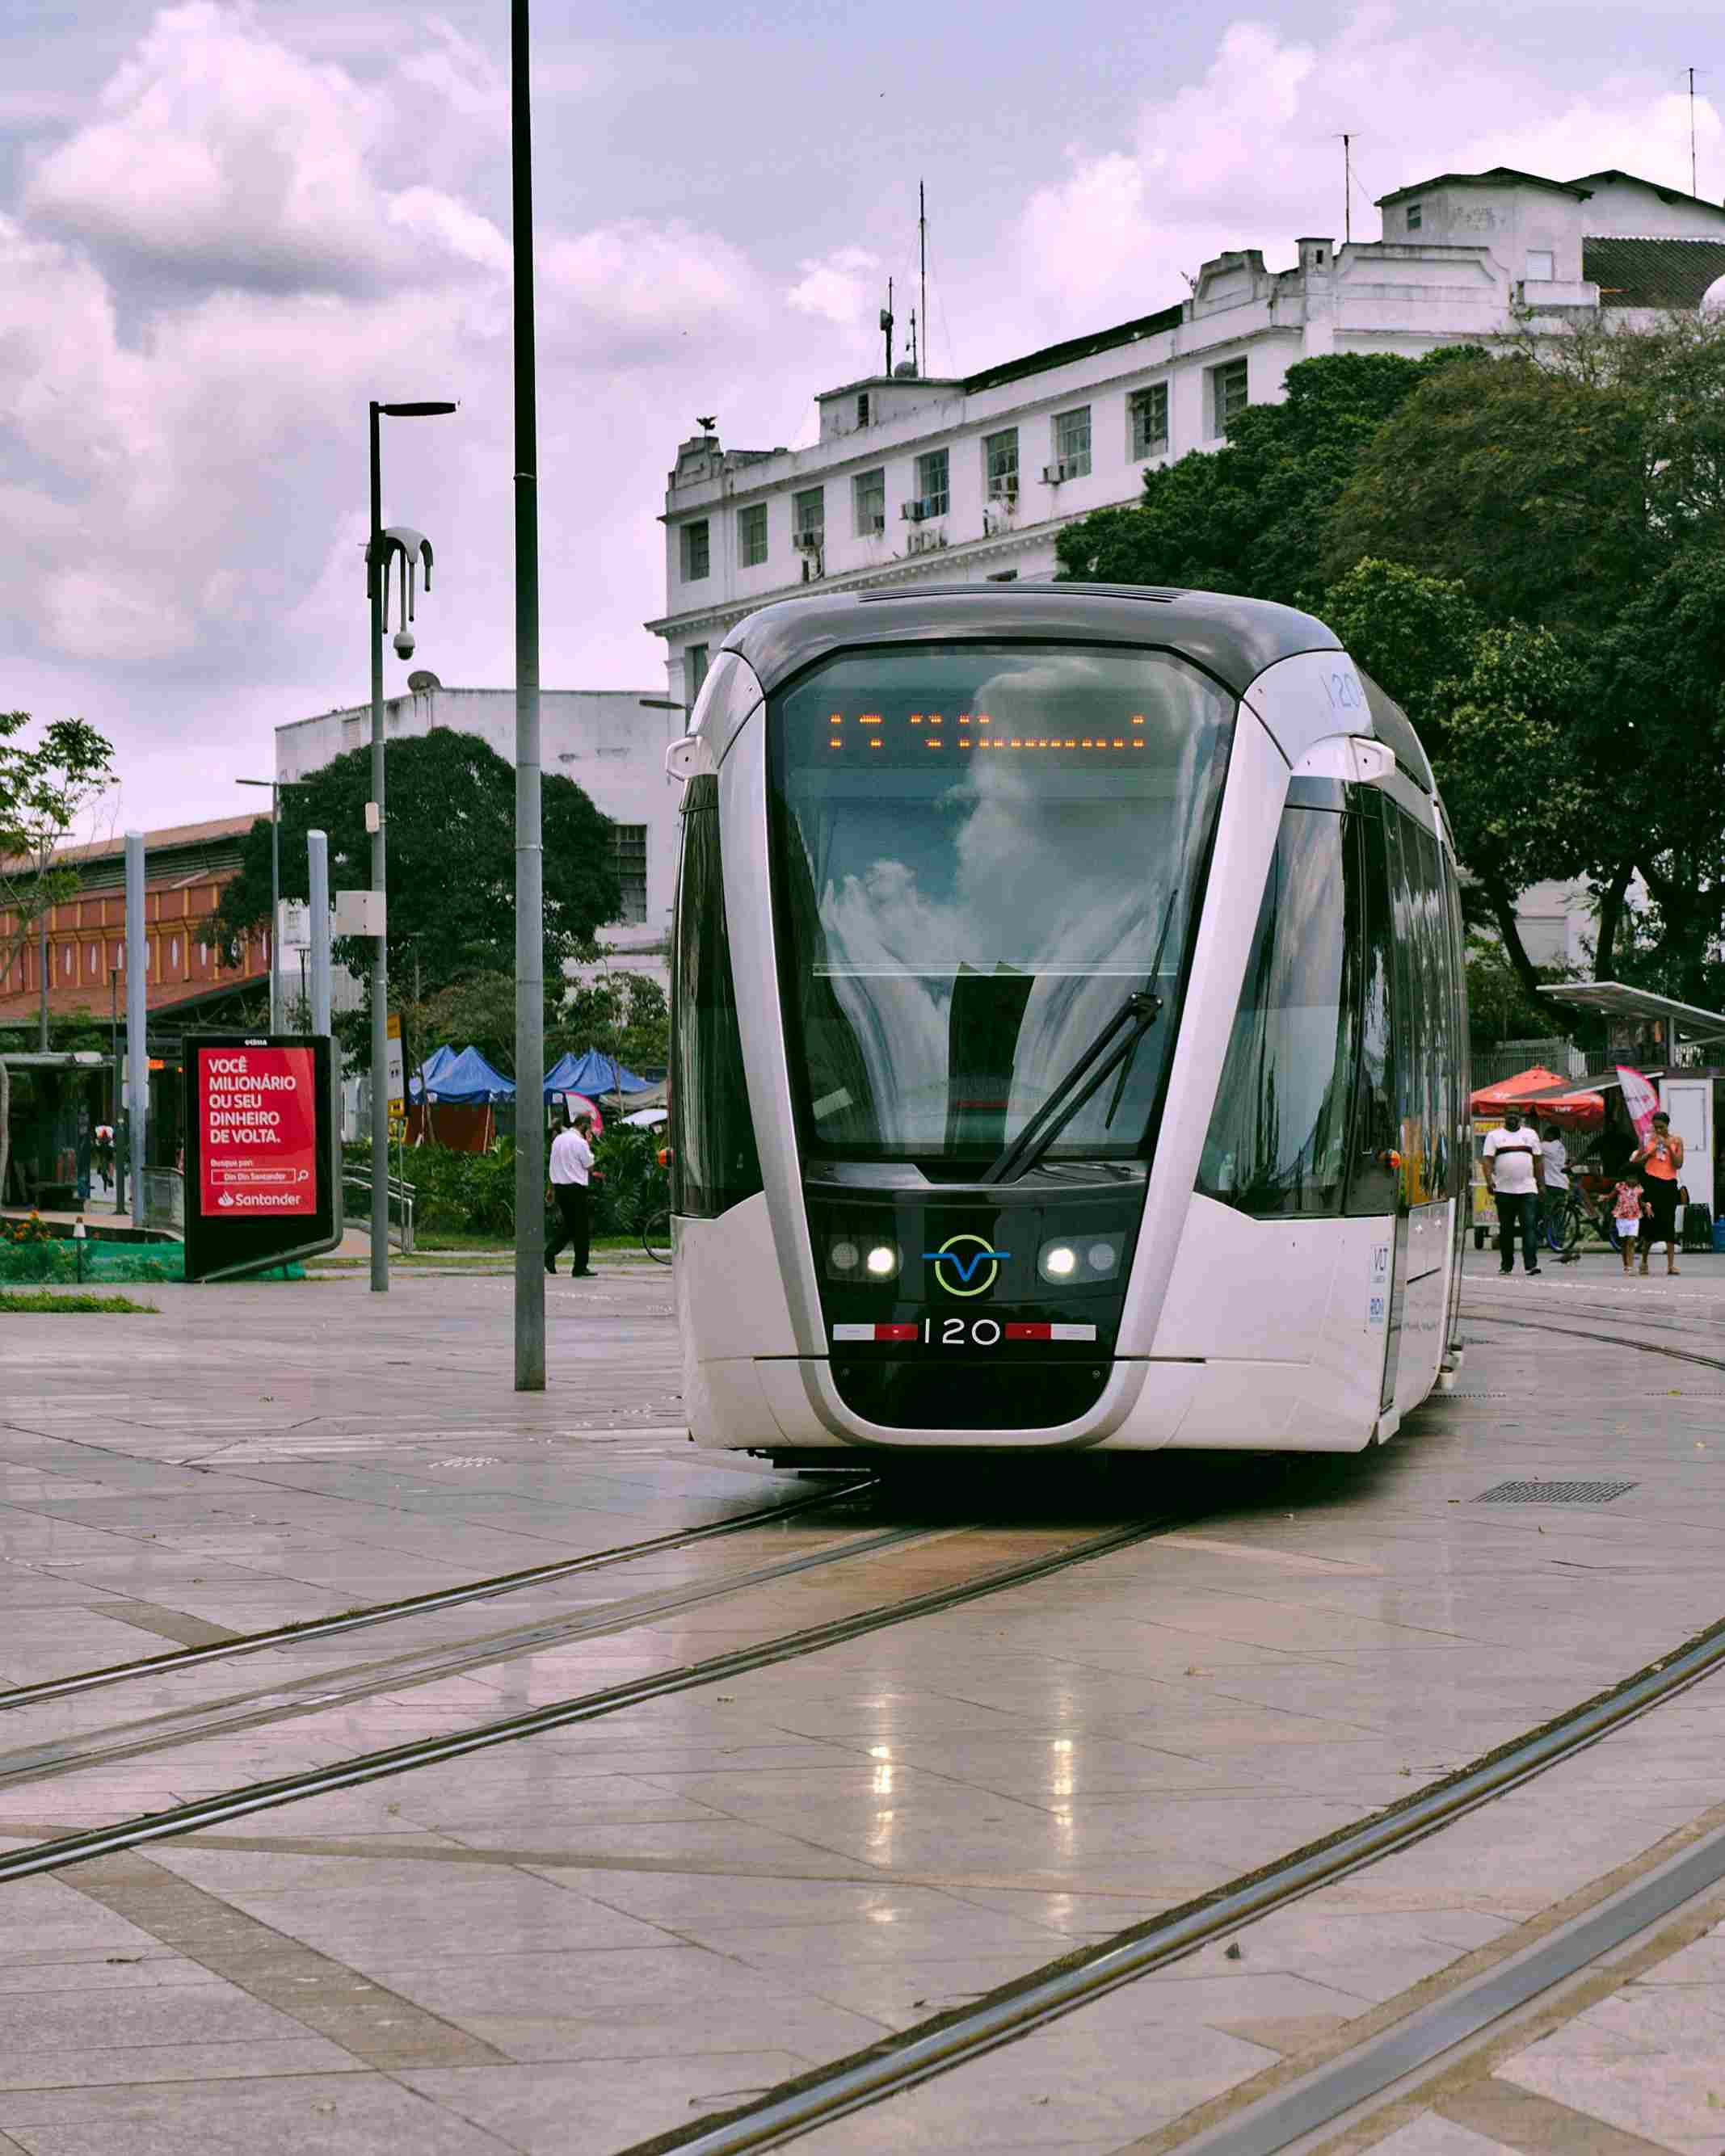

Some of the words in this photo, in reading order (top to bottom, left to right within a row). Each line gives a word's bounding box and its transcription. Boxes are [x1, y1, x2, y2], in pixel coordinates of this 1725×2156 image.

[208, 1055, 248, 1074] VOCÊ
[208, 1073, 297, 1091] MILIONÁRIO
[208, 1093, 232, 1108] OU
[234, 1093, 262, 1108] SEU
[209, 1111, 280, 1126] DINHEIRO
[210, 1128, 229, 1144] DE
[231, 1128, 281, 1144] VOLTA.
[235, 1193, 301, 1206] Santander
[924, 1318, 1001, 1346] 120
